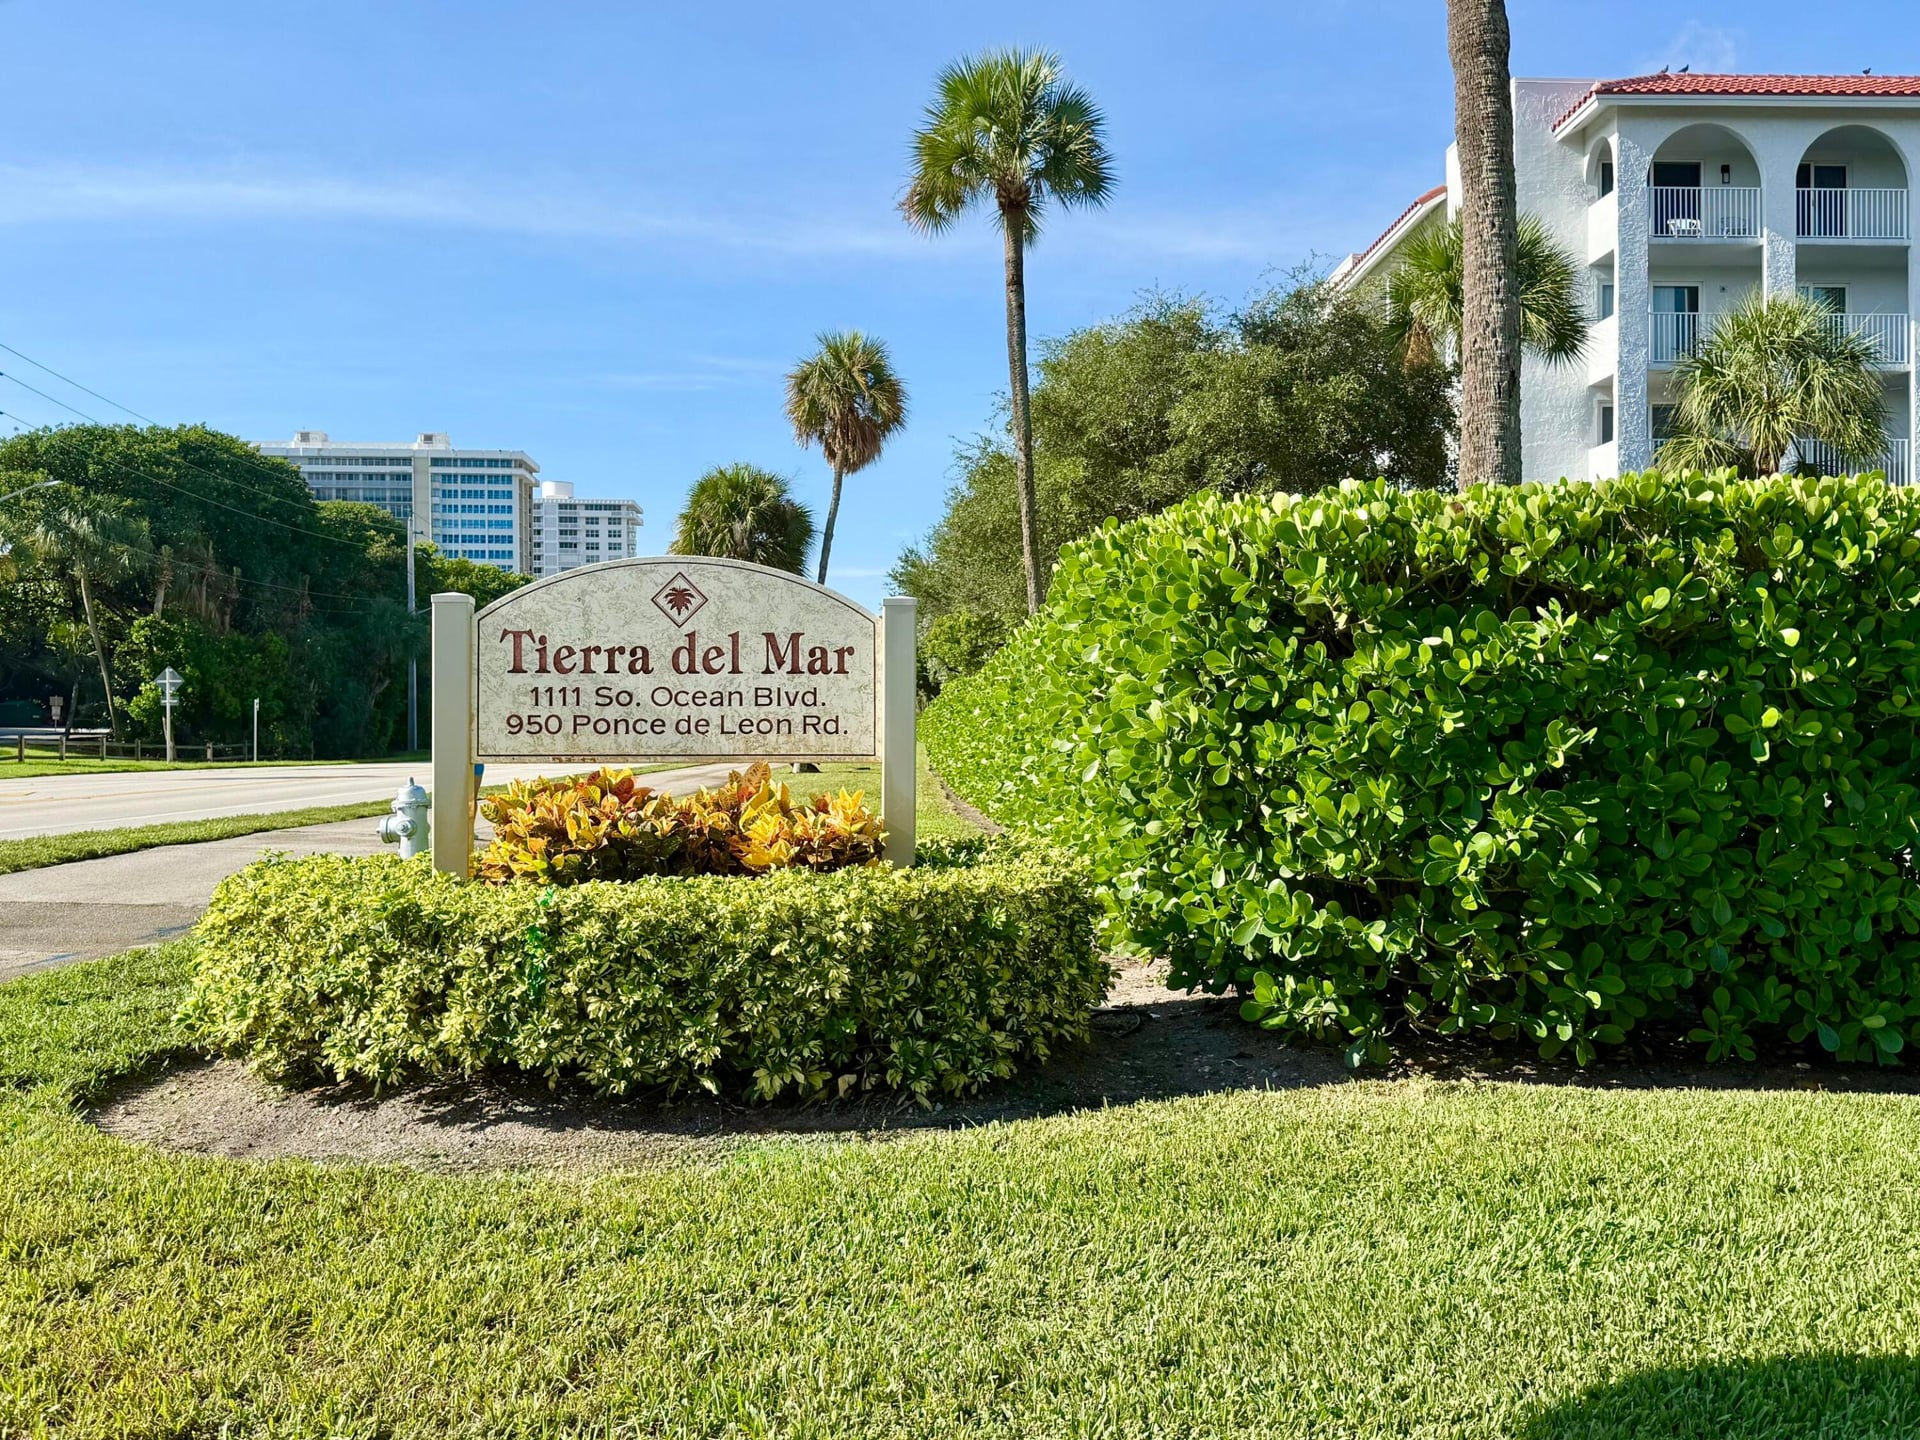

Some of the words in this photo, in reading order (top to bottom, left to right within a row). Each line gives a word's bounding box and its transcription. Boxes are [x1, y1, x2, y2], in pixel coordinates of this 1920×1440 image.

[500, 628, 655, 675] Tierra
[671, 630, 743, 675] del
[761, 632, 855, 675] Mar
[531, 686, 581, 707] 1111
[594, 686, 641, 708] So.
[651, 686, 743, 707] Ocean
[755, 687, 826, 708] Blvd.
[506, 713, 563, 735] 950
[573, 714, 666, 736] Ponce
[675, 714, 710, 736] de
[721, 714, 792, 735] Leon
[803, 714, 848, 736] Rd.
